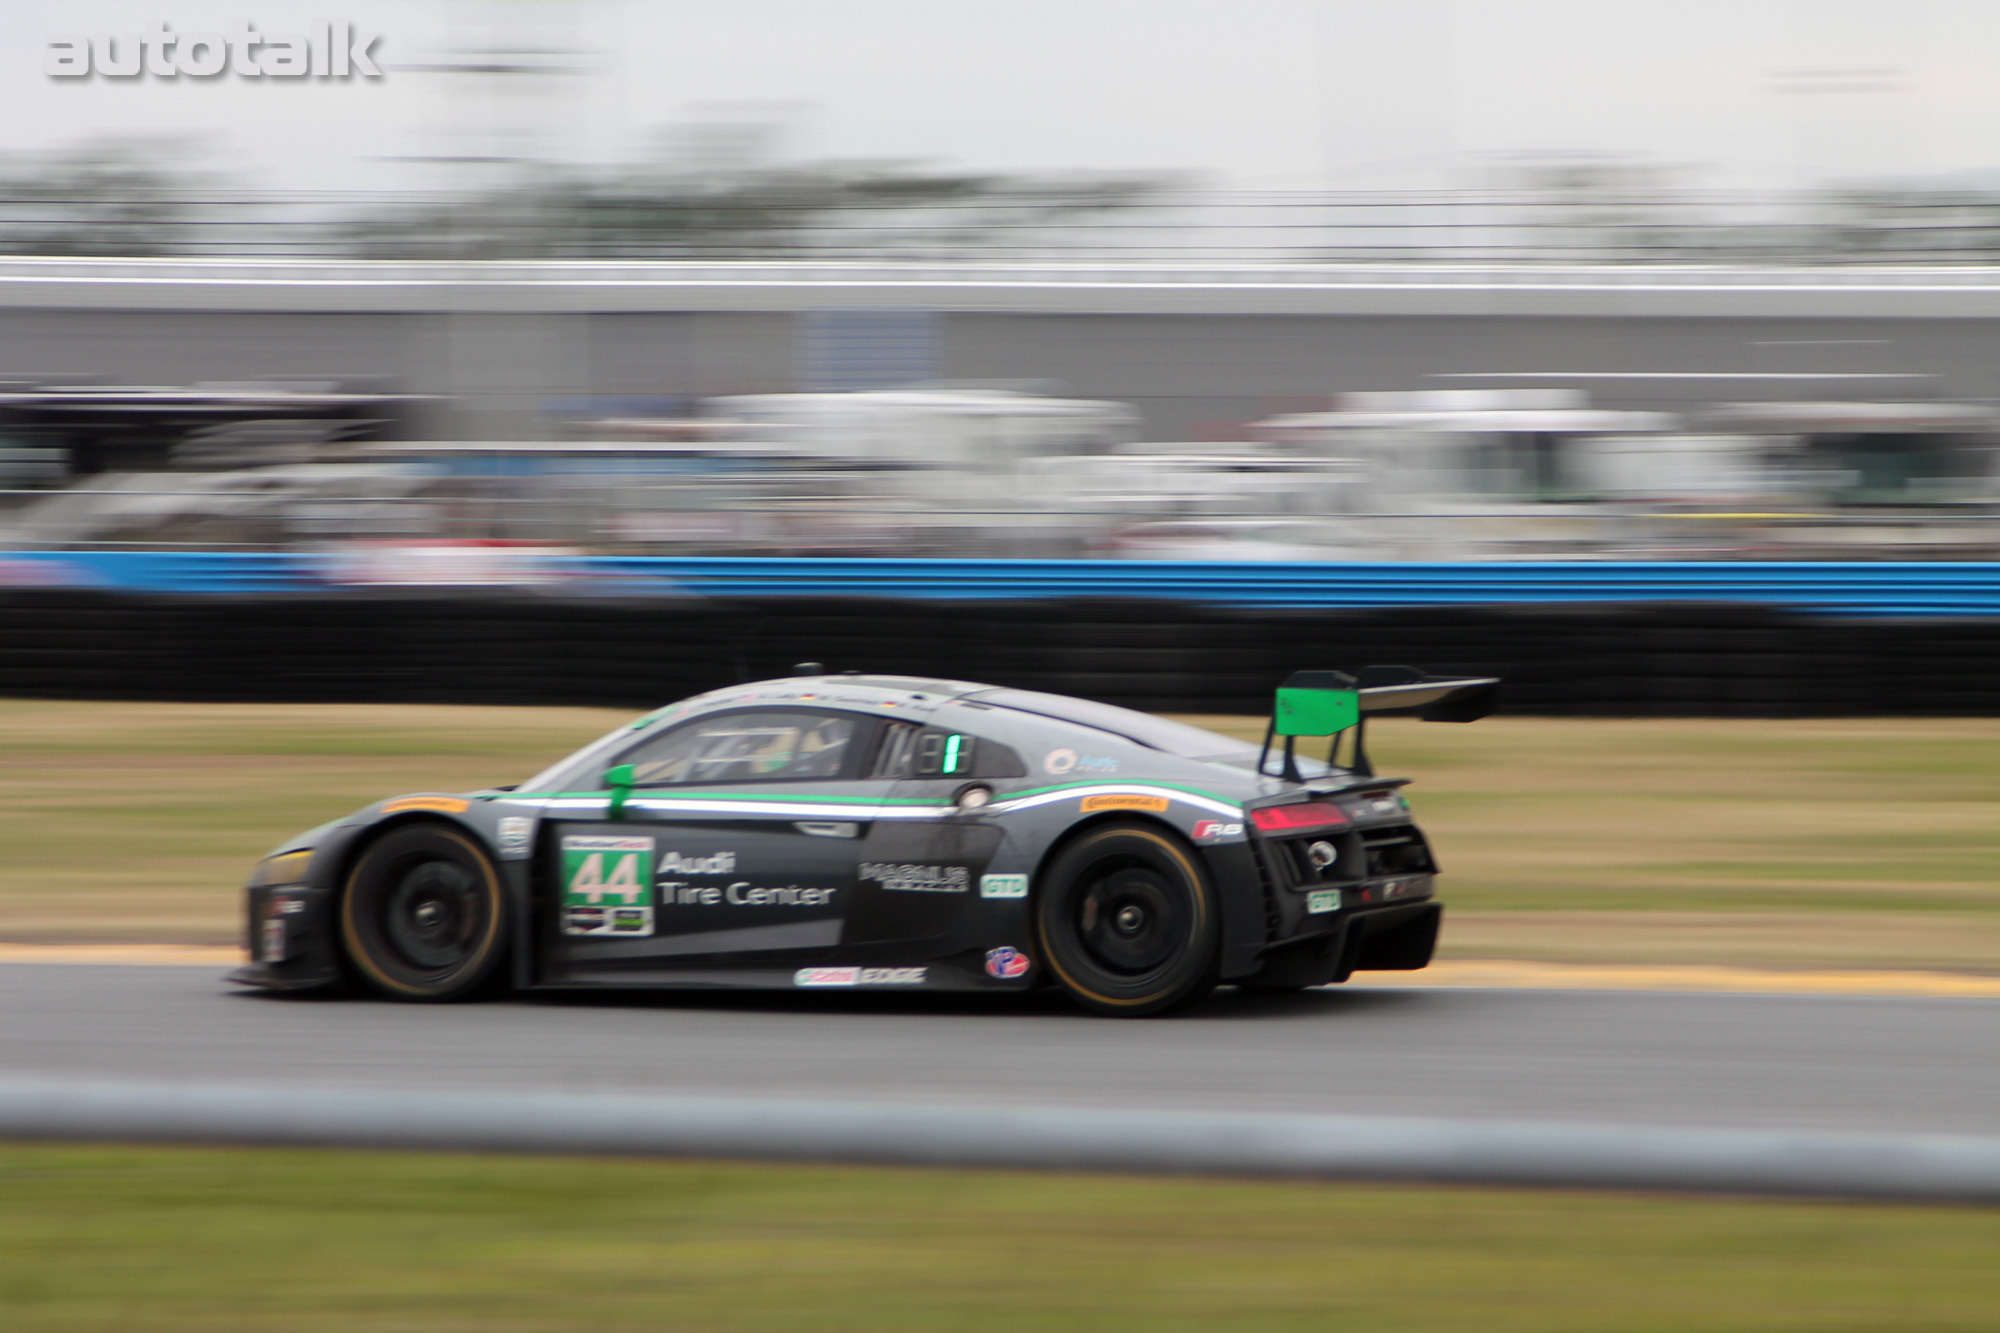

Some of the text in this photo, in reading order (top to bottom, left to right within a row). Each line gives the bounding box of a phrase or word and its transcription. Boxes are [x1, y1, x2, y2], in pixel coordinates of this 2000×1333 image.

[943, 734, 961, 773] 1
[658, 851, 735, 874] Audi
[568, 853, 644, 904] 44
[985, 878, 1026, 893] GTD
[657, 882, 837, 905] Tire Center
[861, 968, 928, 983] EDGE
